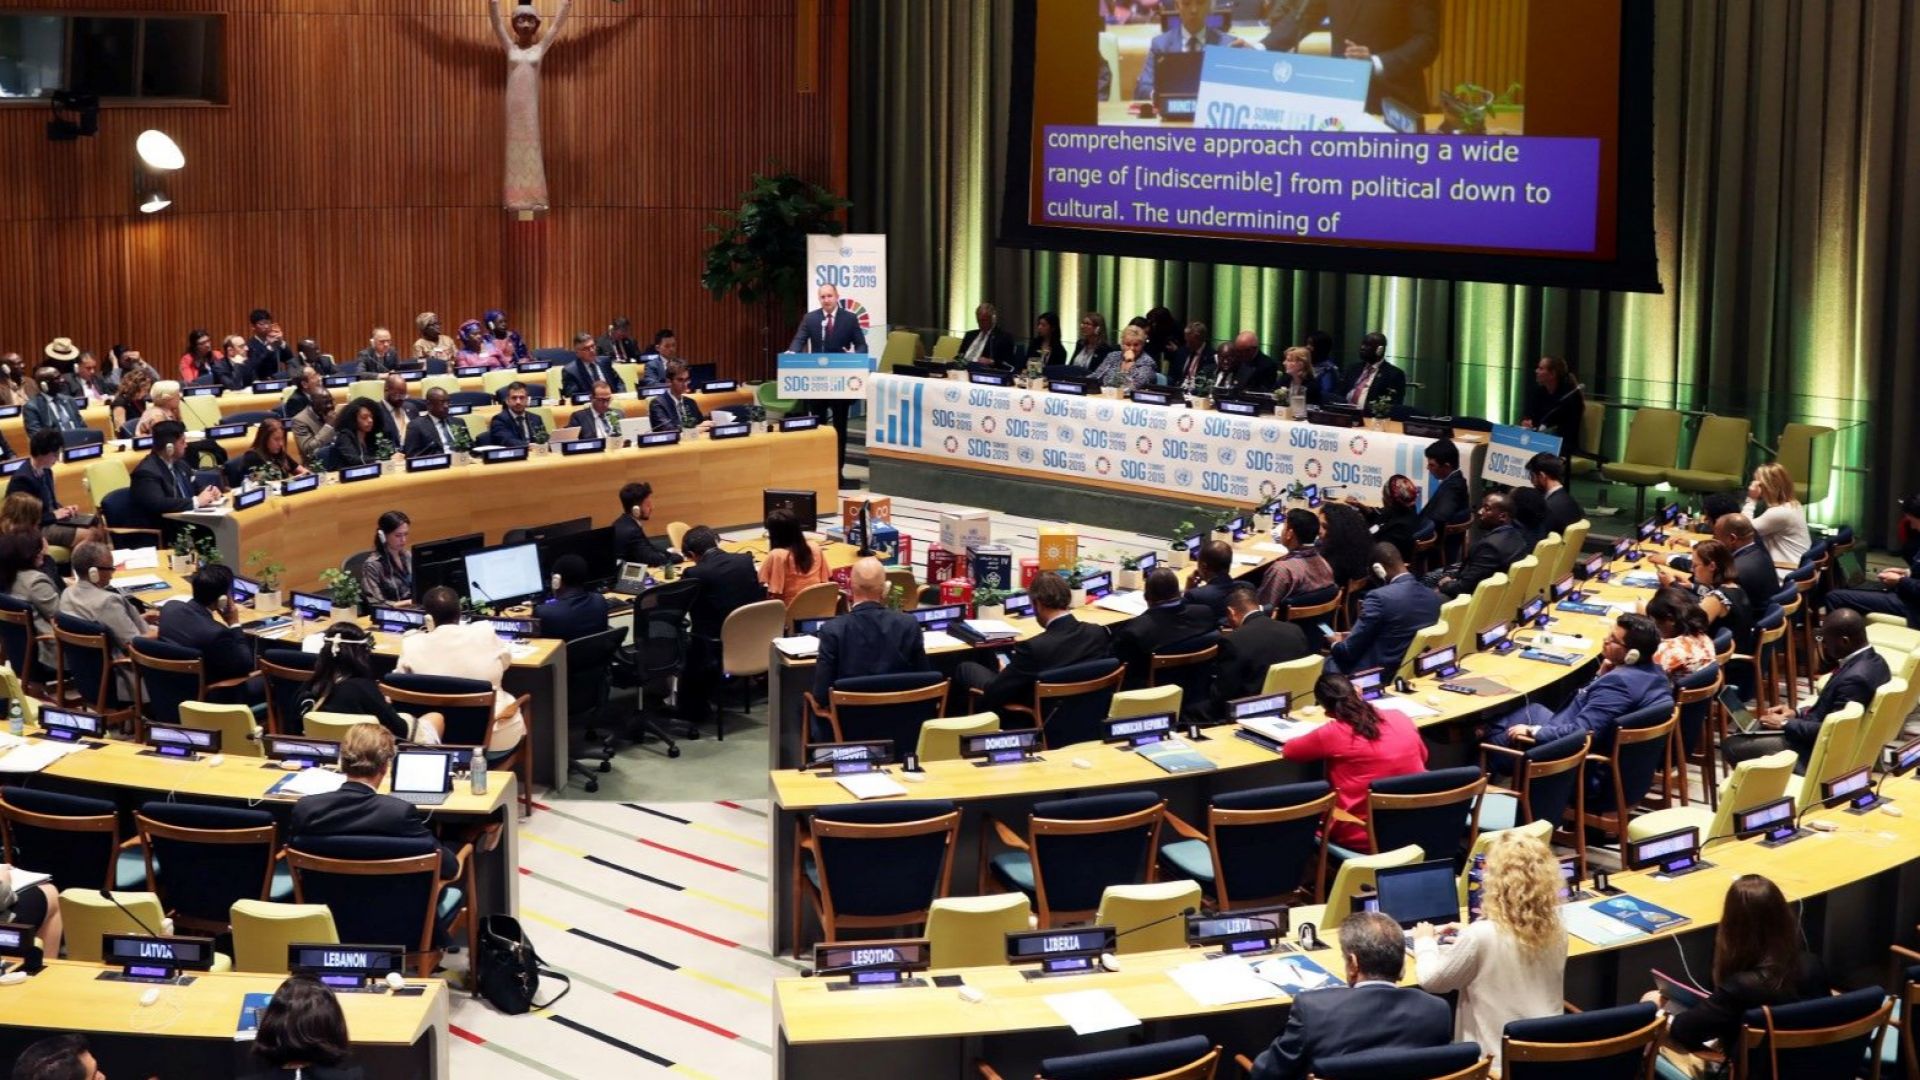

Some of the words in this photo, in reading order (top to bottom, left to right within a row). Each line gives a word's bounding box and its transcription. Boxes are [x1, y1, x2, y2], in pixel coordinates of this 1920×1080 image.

[1048, 130, 1197, 153] comprehensive
[1203, 135, 1302, 158] approach
[1310, 137, 1430, 164] combining
[1438, 144, 1452, 160] a
[1462, 140, 1519, 162] wide
[1048, 166, 1102, 187] range
[1108, 165, 1129, 185] of
[1135, 166, 1282, 197] [indiscernible]
[1290, 172, 1343, 194] from
[1351, 176, 1441, 200] political
[1450, 178, 1516, 203] down
[1525, 182, 1551, 204] to
[1047, 198, 1125, 220] cultural.
[1131, 202, 1169, 222] The
[1176, 206, 1309, 236] undermining
[1317, 212, 1342, 233] of
[816, 265, 851, 288] SDG
[853, 275, 877, 288] 2019
[783, 376, 810, 392] SDG
[968, 388, 993, 407] SDG
[1044, 397, 1069, 416] SDG
[932, 409, 955, 428] SDG
[1122, 407, 1148, 427] SDG
[1204, 417, 1230, 438] SDG
[1005, 418, 1030, 438] SDG
[1082, 428, 1108, 449] SDG
[967, 438, 991, 458] SDG
[1162, 438, 1188, 460] SDG
[1289, 427, 1318, 449] SDG
[1318, 439, 1338, 452] 2019
[1042, 448, 1067, 469] SDG
[1246, 449, 1273, 471] SDG
[1274, 462, 1294, 475] 2019
[1488, 452, 1510, 474] SDG
[1121, 459, 1146, 480] SDG
[1331, 461, 1360, 484] SDG
[1362, 474, 1382, 488] 2019
[1202, 470, 1229, 493] SDG
[140, 943, 173, 959] LATVIA
[1043, 935, 1080, 953] LIBERIA
[323, 952, 367, 968] LEBANON
[851, 948, 894, 965] LESOTHO
